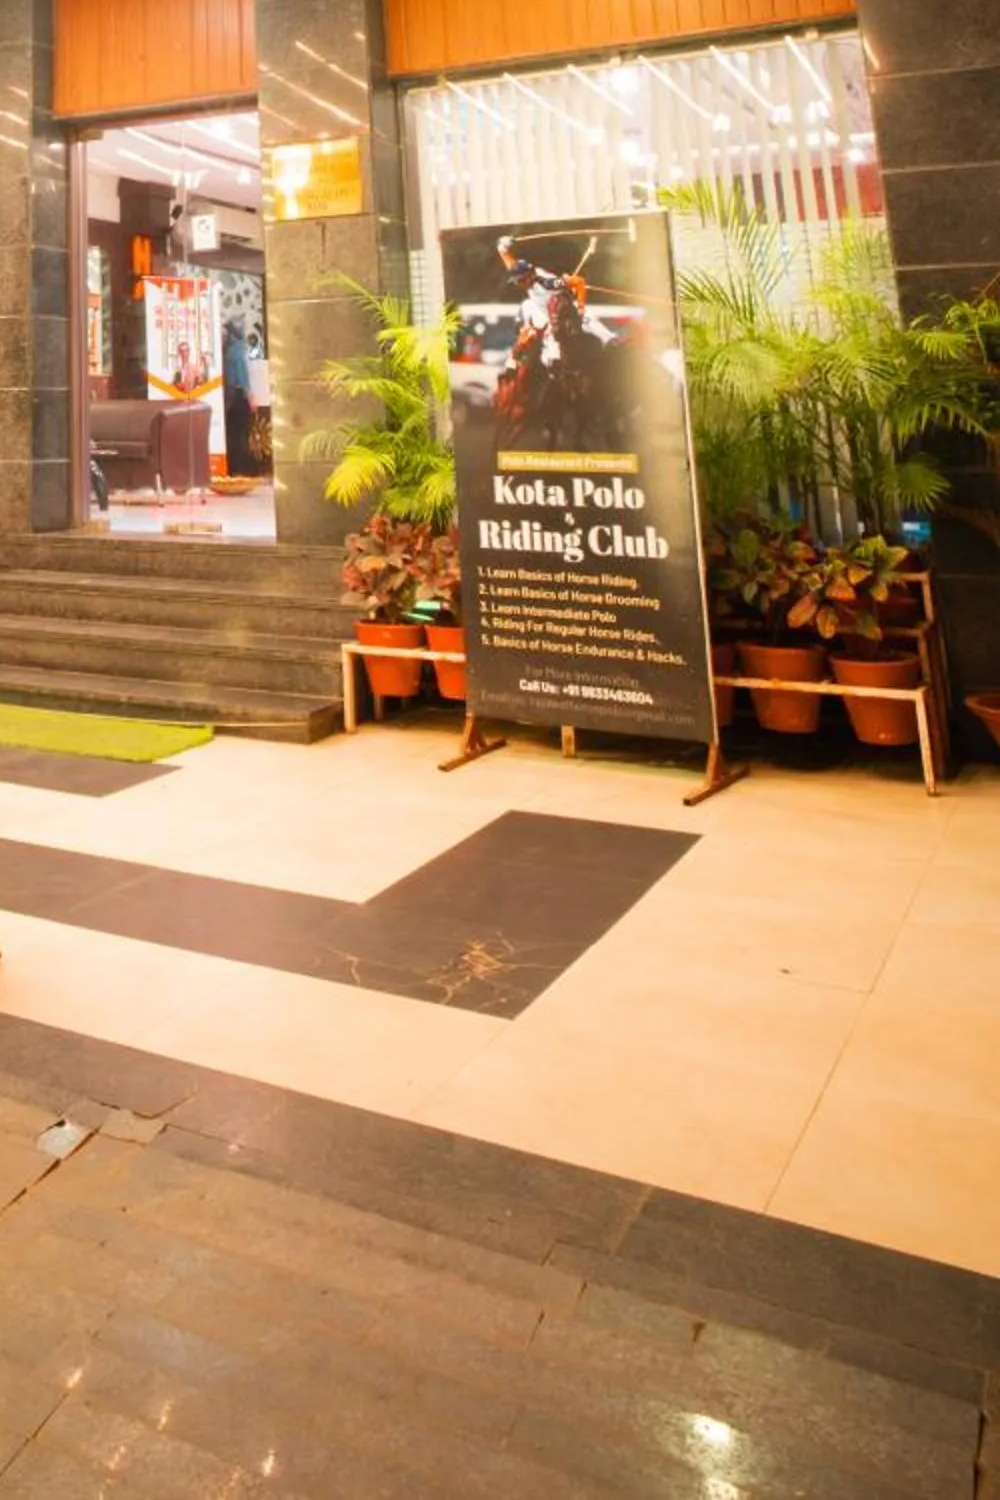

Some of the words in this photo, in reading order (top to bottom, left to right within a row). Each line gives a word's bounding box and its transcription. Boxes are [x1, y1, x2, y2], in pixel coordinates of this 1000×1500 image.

[493, 475, 568, 507] Kota
[572, 477, 645, 509] Polo
[478, 519, 585, 563] Riding
[588, 524, 670, 559] Club
[487, 567, 516, 579] Learn
[518, 568, 552, 582] Basics
[554, 571, 565, 582] of
[567, 572, 599, 585] Horse
[479, 583, 489, 595] 2.
[490, 584, 520, 597] Learn
[521, 586, 556, 600] Basics
[558, 589, 569, 601] of
[571, 590, 603, 604] Horse
[605, 592, 660, 611] Grooming
[479, 600, 489, 612] 3.
[491, 602, 520, 614] Learn
[522, 604, 590, 620] Intermediate
[591, 609, 617, 623] Polo
[492, 617, 525, 633] Riding
[545, 621, 586, 637] Regular
[589, 626, 621, 639] Horse
[493, 635, 527, 650] Basics
[528, 639, 540, 650] of
[541, 640, 574, 654] Horse
[575, 642, 634, 660] Endurance
[635, 649, 645, 660] &
[519, 679, 540, 692] Call
